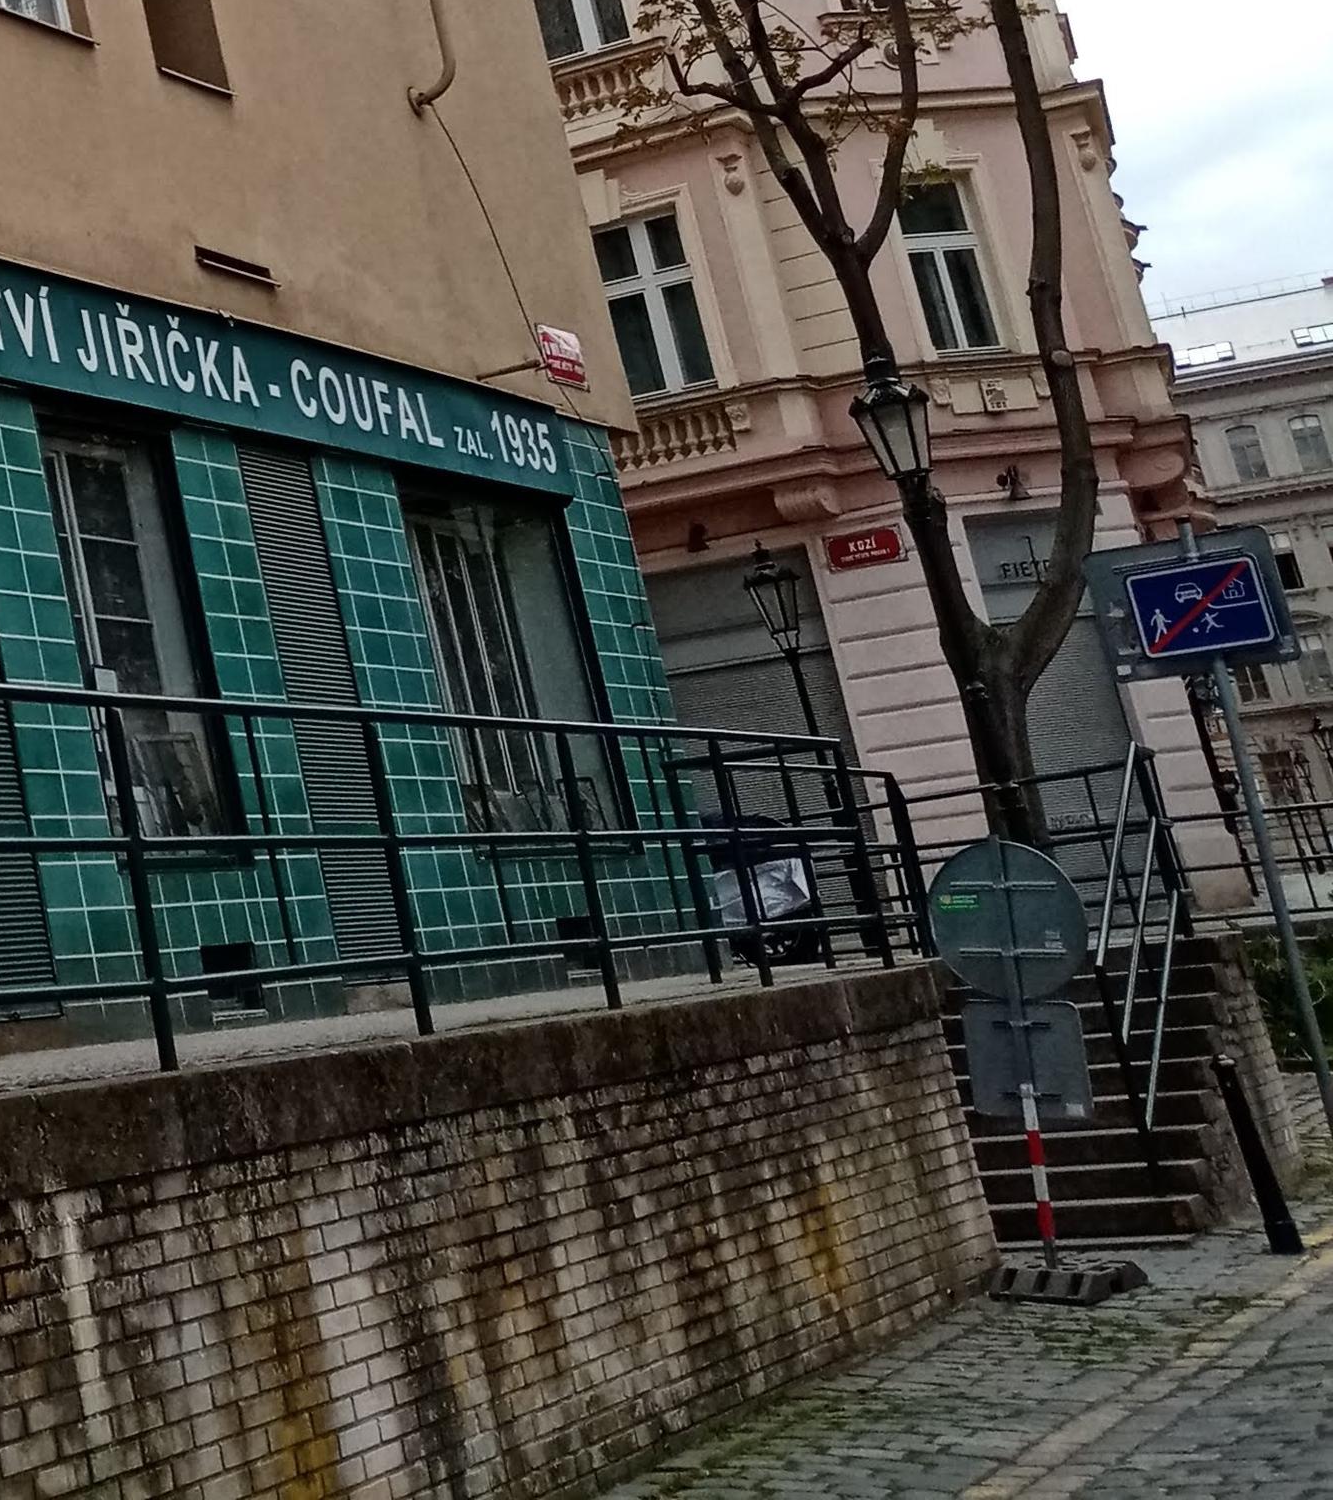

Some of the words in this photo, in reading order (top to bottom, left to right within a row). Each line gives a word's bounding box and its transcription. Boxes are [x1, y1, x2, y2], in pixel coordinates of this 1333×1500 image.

[76, 302, 261, 408] JIŘIČKA
[290, 358, 445, 449] COUFAL
[453, 426, 494, 461] ZAL.
[490, 410, 557, 474] 1935
